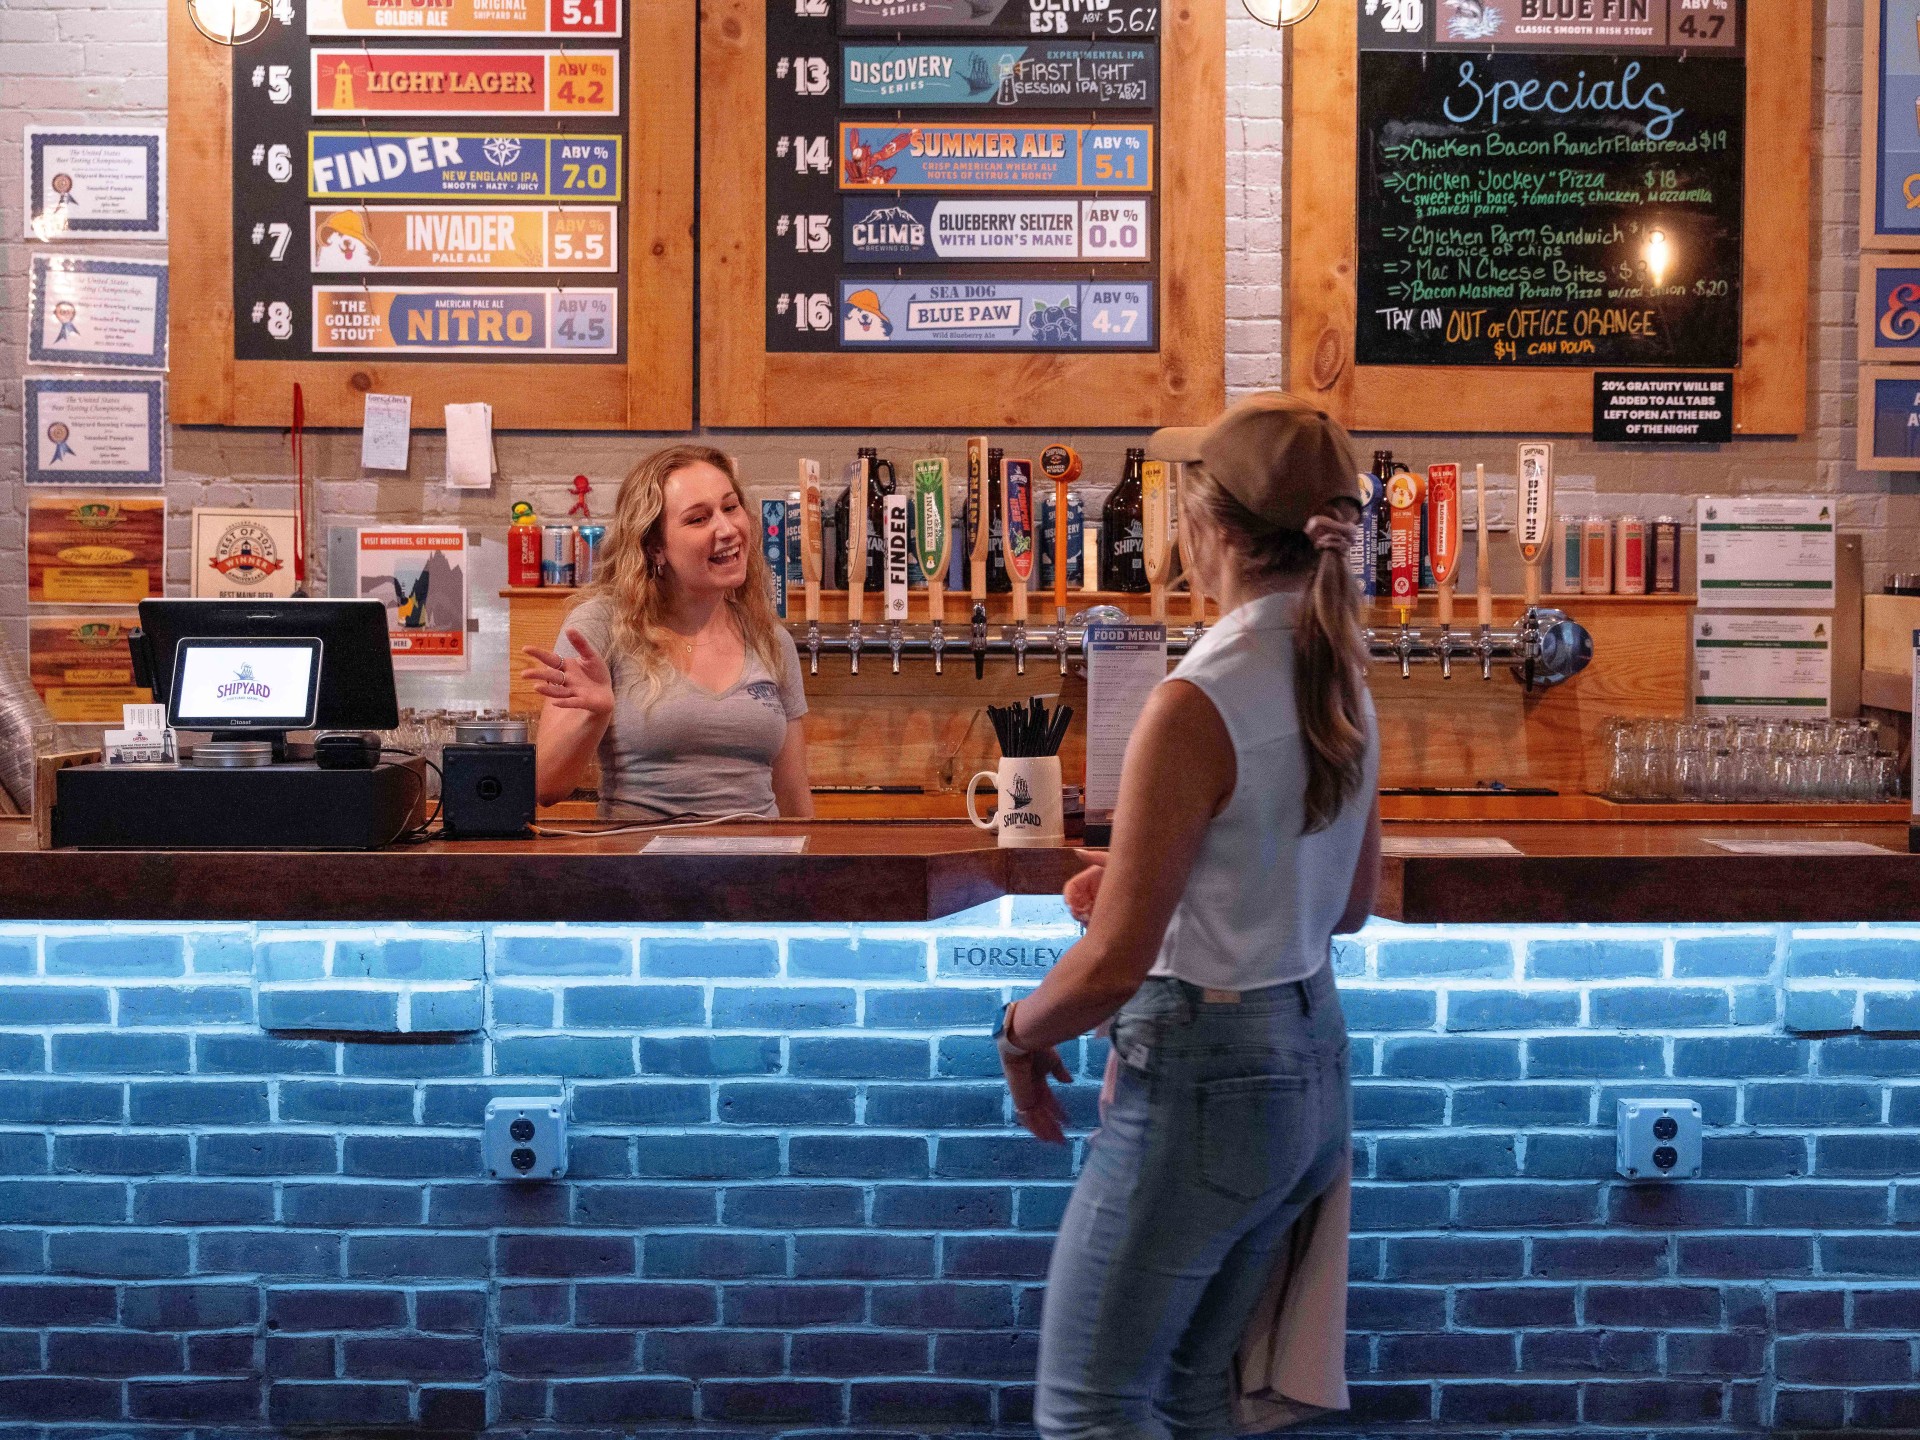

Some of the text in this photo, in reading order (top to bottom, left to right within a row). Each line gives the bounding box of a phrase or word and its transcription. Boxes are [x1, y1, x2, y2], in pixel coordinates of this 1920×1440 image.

[374, 10, 448, 26] GOLDEN ALE
[562, 0, 604, 25] 5.1
[882, 3, 926, 17] SERIES
[1106, 8, 1157, 34] 5.6%
[1364, 0, 1424, 33] #20
[1521, 0, 1650, 23] BLUE FIN
[1029, 11, 1068, 33] ESB
[1514, 25, 1654, 36] CLASSIC SMOOTH IRISH STOUT
[1678, 15, 1726, 39] 4.7
[1047, 51, 1145, 60] EXPERIMENTAL IPA
[557, 62, 587, 77] ABV
[776, 57, 830, 96] #13
[850, 55, 953, 84] DISCOVERY
[251, 65, 292, 104] #5
[366, 71, 535, 95] LIGHT LAGER
[557, 81, 604, 105] 4.2
[881, 81, 925, 95] SERIES
[1014, 81, 1098, 94] SESSION IPA
[1442, 60, 1685, 141] Specials
[562, 146, 591, 159] ABV
[909, 132, 1067, 159] SUMMER ALE
[1093, 137, 1122, 149] ABV
[1409, 129, 1728, 161] Chicken Bacon Ranch Flatbread $19
[251, 143, 292, 183] #6
[313, 136, 463, 192] FINDER
[776, 136, 832, 175] #14
[1095, 154, 1135, 179] 5.1
[442, 170, 539, 183] NEW ENGLAND IPA
[562, 164, 607, 189] 7.0
[922, 162, 1057, 172] CRISP AMERICAN WHEAT ALE
[927, 171, 1053, 181] NOTES CITRUS HONEY
[442, 182, 539, 191] SMOOTH HAZY JUICY
[1405, 168, 1606, 192] Chicken Pizza
[1413, 190, 1482, 206] sweet chili
[939, 213, 1073, 232] BLUEBERRY SELTZER
[1089, 209, 1120, 223] ABV
[1473, 205, 1508, 218] parm
[406, 214, 514, 251] INVADER
[555, 219, 586, 233] ABV
[776, 214, 832, 253] #15
[852, 223, 926, 246] CLIMB
[1089, 225, 1138, 249] 0.0
[1412, 223, 1625, 246] Chicken Parm Sandwich
[251, 222, 292, 262] #7
[553, 234, 604, 260] 5.5
[865, 244, 898, 252] BREWING
[939, 233, 1073, 247] WITH MANE
[432, 253, 491, 264] PALE ALE
[1436, 243, 1562, 261] choice chips
[1416, 256, 1608, 283] Mac Cheese Bites
[930, 285, 996, 300] SEA DOG
[1093, 291, 1121, 305] ABV
[1411, 279, 1603, 303] Bacon Mashed Potato Pizza
[435, 299, 504, 309] AMERICAN PALE ALE
[557, 299, 587, 314] ABV
[776, 293, 832, 331] #16
[917, 304, 1012, 324] BLUE PAW
[251, 301, 292, 340] #8
[325, 314, 381, 327] GOLDEN
[407, 308, 533, 342] NITRO
[557, 318, 606, 342] 4.5
[1092, 309, 1138, 335] 4.7
[1376, 307, 1657, 343] TRY AN OUT OFFICE ORANGE
[949, 332, 984, 341] Blueberry
[1494, 339, 1596, 361] $4 CAN POUR
[1602, 381, 1725, 392] 20% GRATUITY WILL BE
[1610, 396, 1716, 406] ADDED TO ALL TABS
[1604, 410, 1721, 420] LEFT OPEN AT THE END
[1626, 424, 1699, 434] OF THE NIGHT
[1524, 448, 1545, 456] SHIPYARD
[1525, 480, 1539, 540] BLUE FIN
[220, 528, 273, 556] BEST OF 2024
[364, 537, 379, 545] VISIT
[416, 537, 427, 545] GET
[428, 537, 460, 545] REWARDED
[890, 506, 906, 585] FINDER
[1392, 529, 1407, 568] SUNFISH
[225, 557, 268, 569] WINNER
[1094, 630, 1161, 641] FOOD MENU
[216, 682, 271, 699] SHIPYARD
[1003, 812, 1042, 829] SHIPYARD
[952, 946, 1063, 968] FORSLEY
